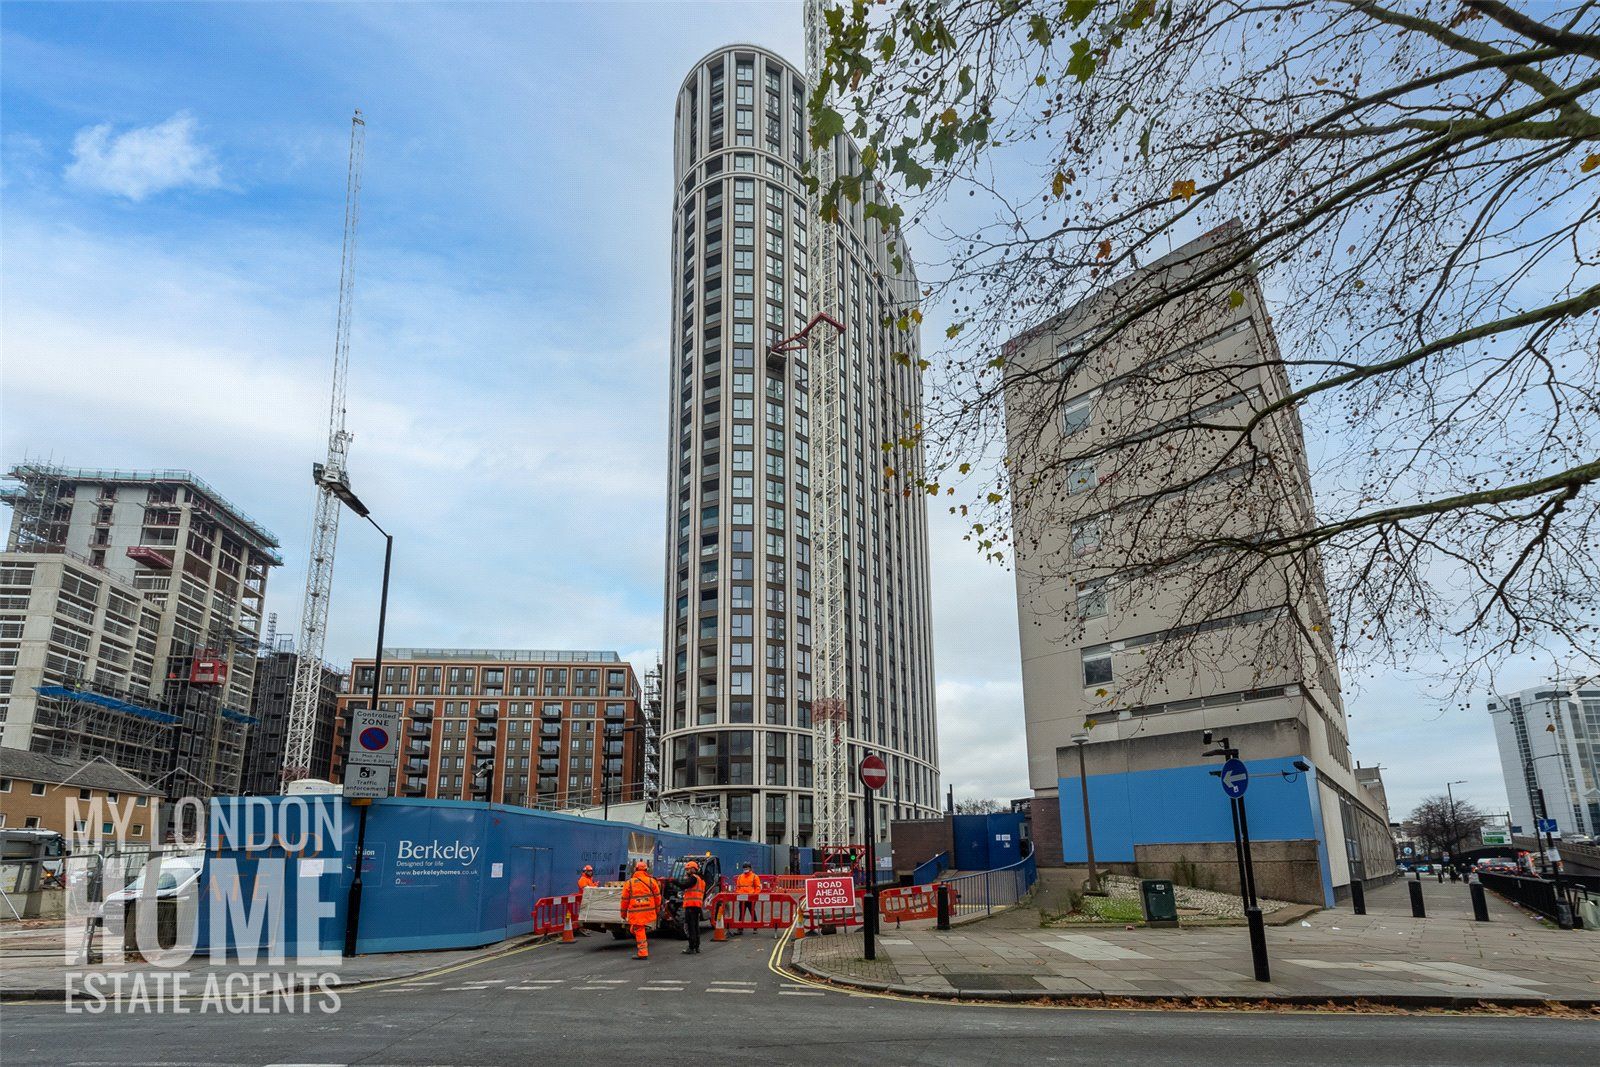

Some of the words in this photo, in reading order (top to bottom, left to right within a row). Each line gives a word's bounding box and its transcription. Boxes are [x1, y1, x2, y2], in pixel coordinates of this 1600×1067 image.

[357, 711, 396, 719] Controlled
[361, 718, 389, 726] ZONE
[397, 840, 480, 866] Berkeley
[395, 869, 479, 879] www.berkeleyhomes.co.uk
[816, 889, 845, 897] AHEAD
[813, 897, 848, 905] CLOSED
